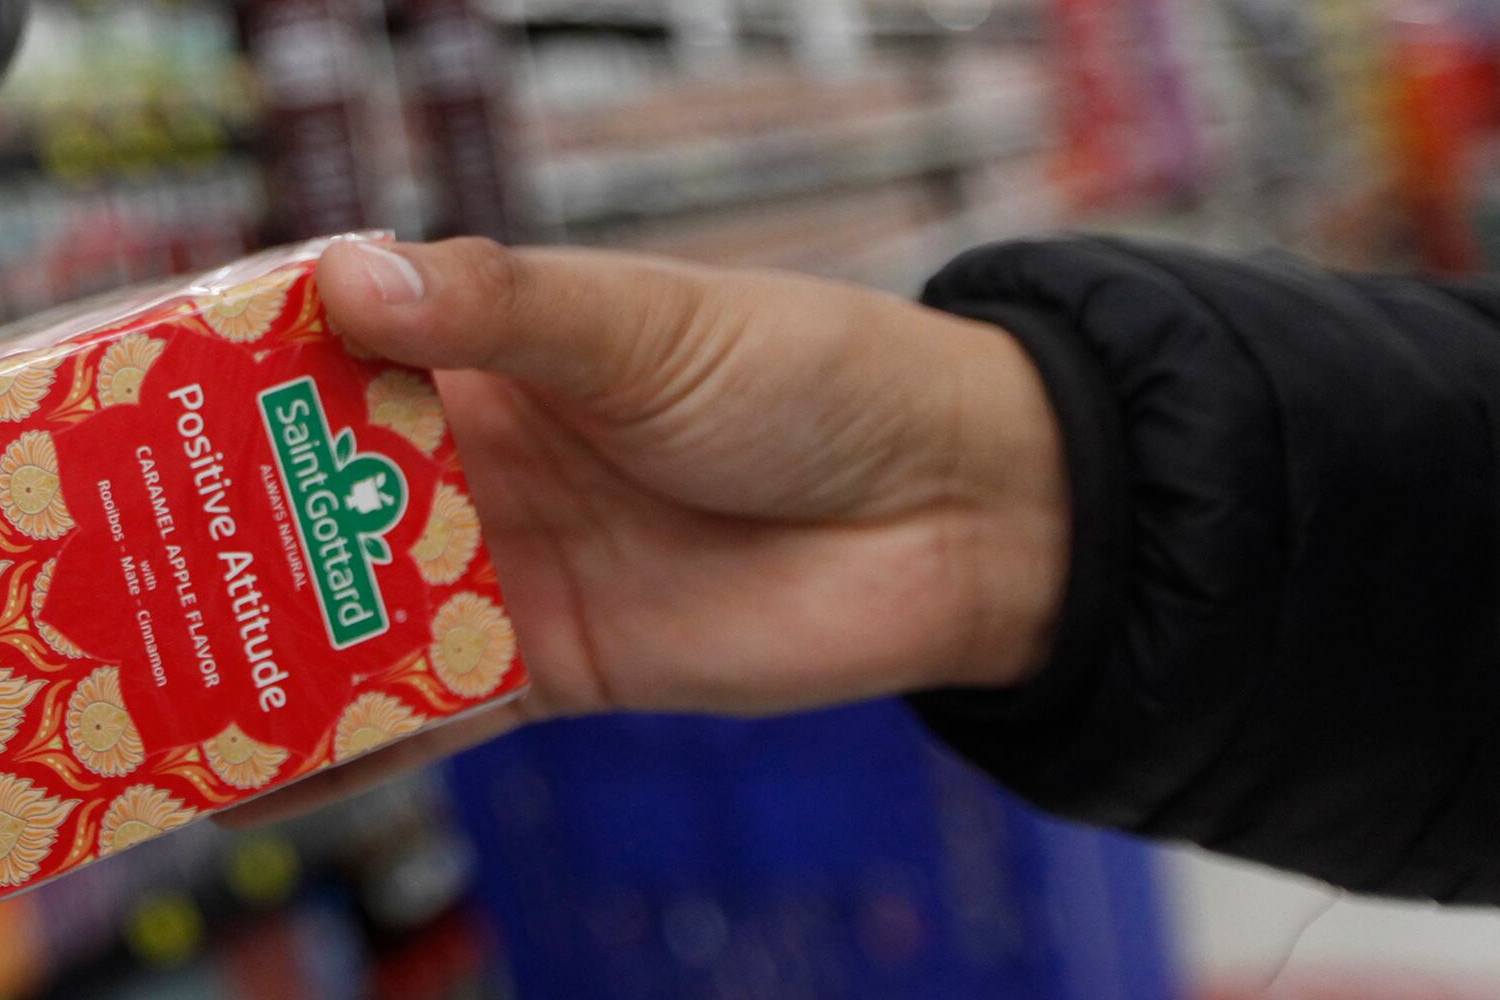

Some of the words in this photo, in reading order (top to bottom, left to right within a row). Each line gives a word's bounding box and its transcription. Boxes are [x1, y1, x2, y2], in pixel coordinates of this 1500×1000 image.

[98, 479, 125, 542] Rooibos
[121, 556, 141, 595] Mate
[137, 610, 168, 687] Cinnamon
[136, 445, 176, 540] CARAMEL
[165, 544, 197, 607] APPLE
[186, 610, 220, 688] FLAVOR
[140, 560, 157, 591] with
[168, 383, 236, 542] Positive
[218, 551, 289, 713] Attitude
[260, 464, 288, 521] ALWAYS
[278, 523, 306, 590] NATURAL
